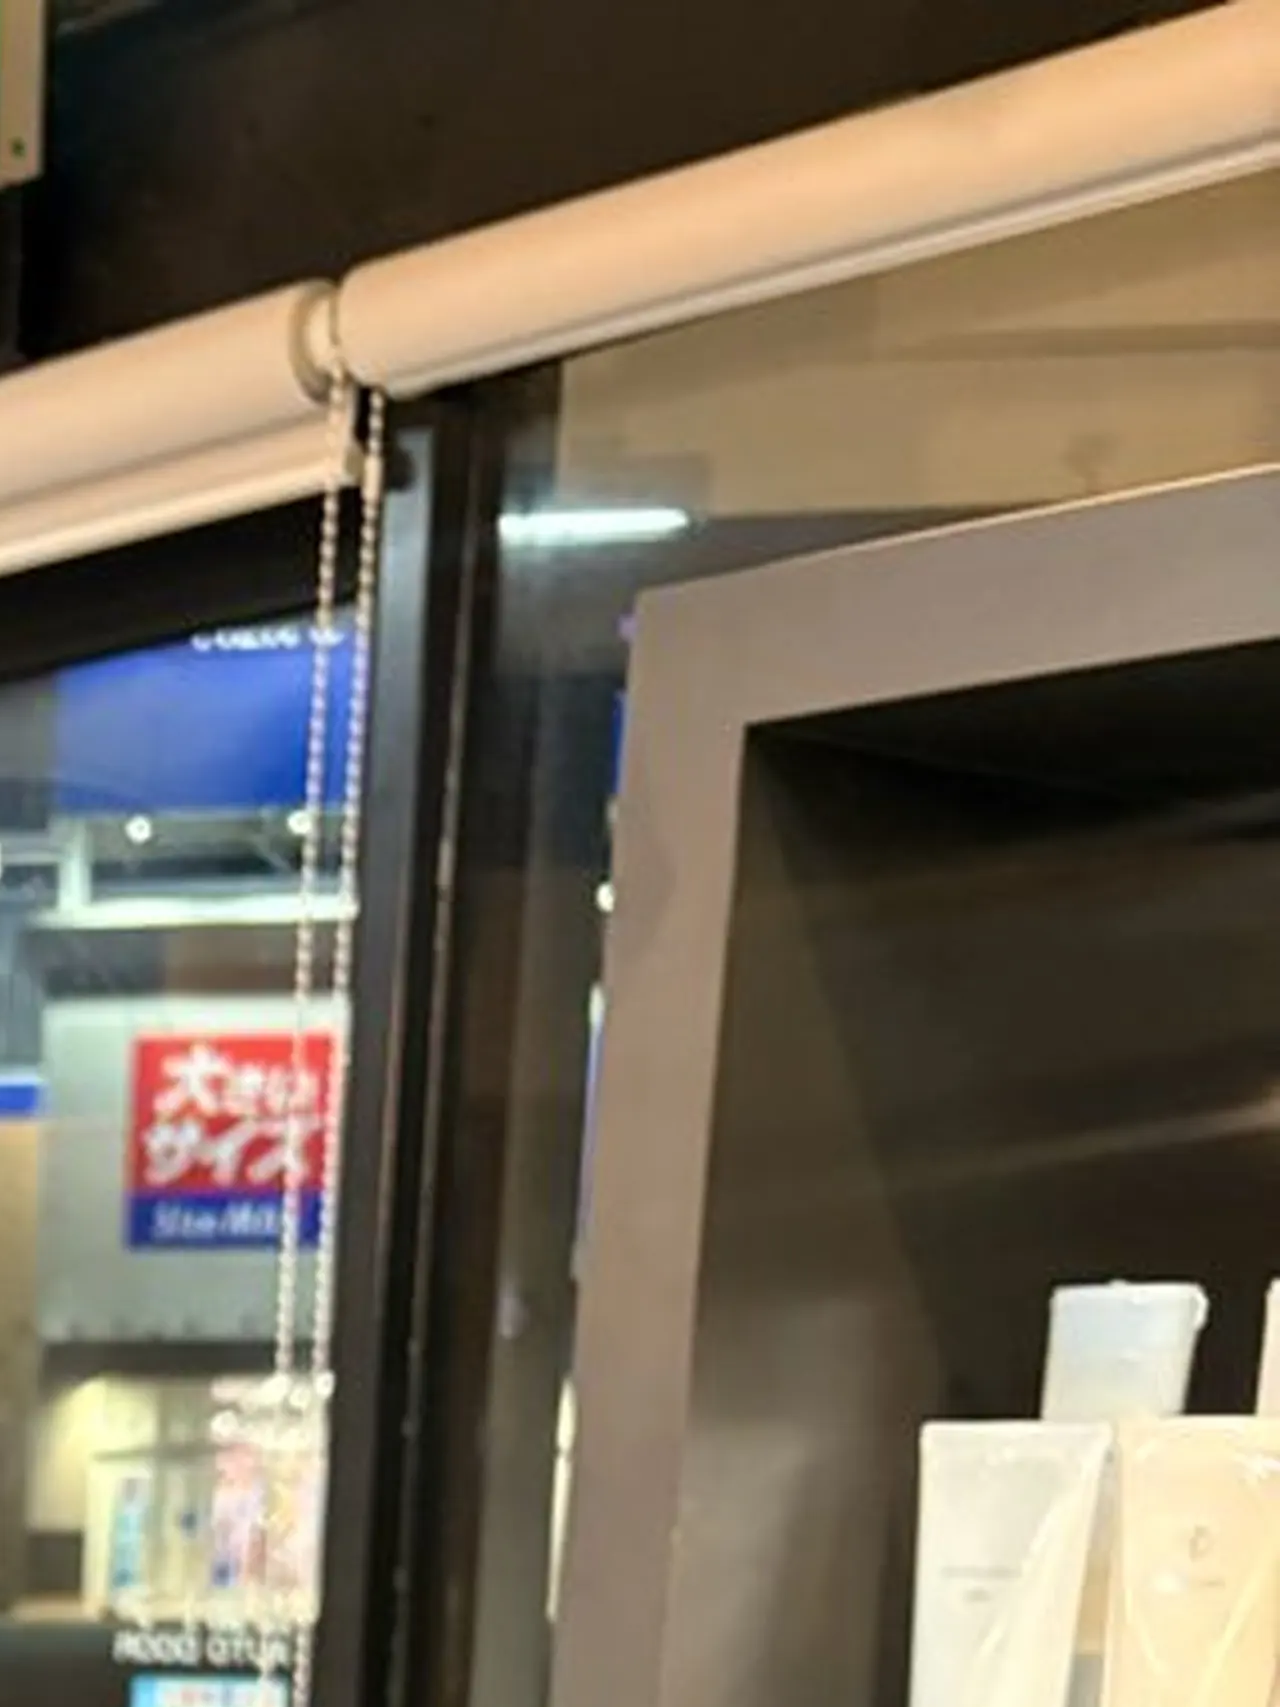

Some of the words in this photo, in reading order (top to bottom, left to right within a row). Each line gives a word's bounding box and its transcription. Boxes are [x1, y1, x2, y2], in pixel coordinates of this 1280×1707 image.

[153, 1043, 320, 1117] 大きい
[142, 1117, 322, 1187] サイズ
